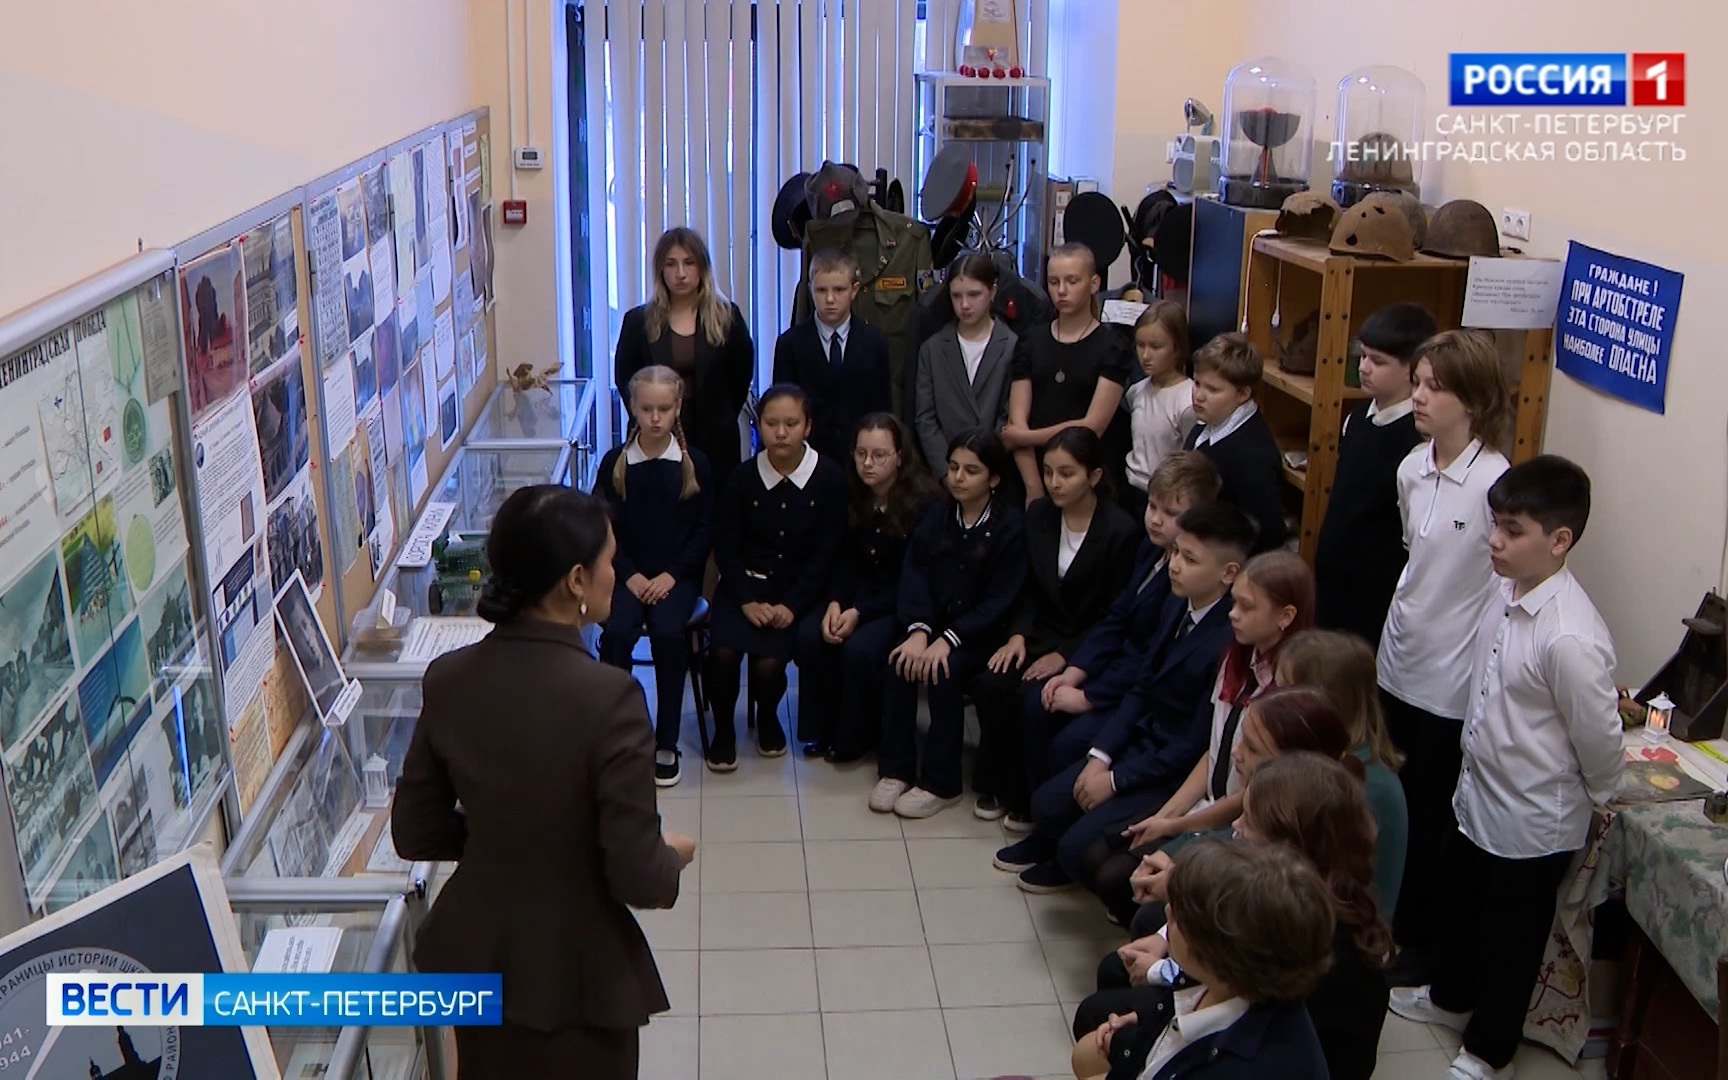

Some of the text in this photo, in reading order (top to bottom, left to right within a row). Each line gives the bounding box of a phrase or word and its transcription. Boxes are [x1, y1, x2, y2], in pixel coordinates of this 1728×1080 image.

[1588, 263, 1651, 296] ГРАЖДАНЕ
[1571, 280, 1665, 331] ПРИ АРТОБСТРЕЛЕ
[1567, 306, 1661, 356] ЭТА СТОРОНА УЛИЦЫ
[1563, 333, 1657, 385] НАИБОЛЕЕ ОПАСНА
[0, 957, 54, 998] РАНИЦЫ
[58, 952, 118, 967] ИСТОРИИ
